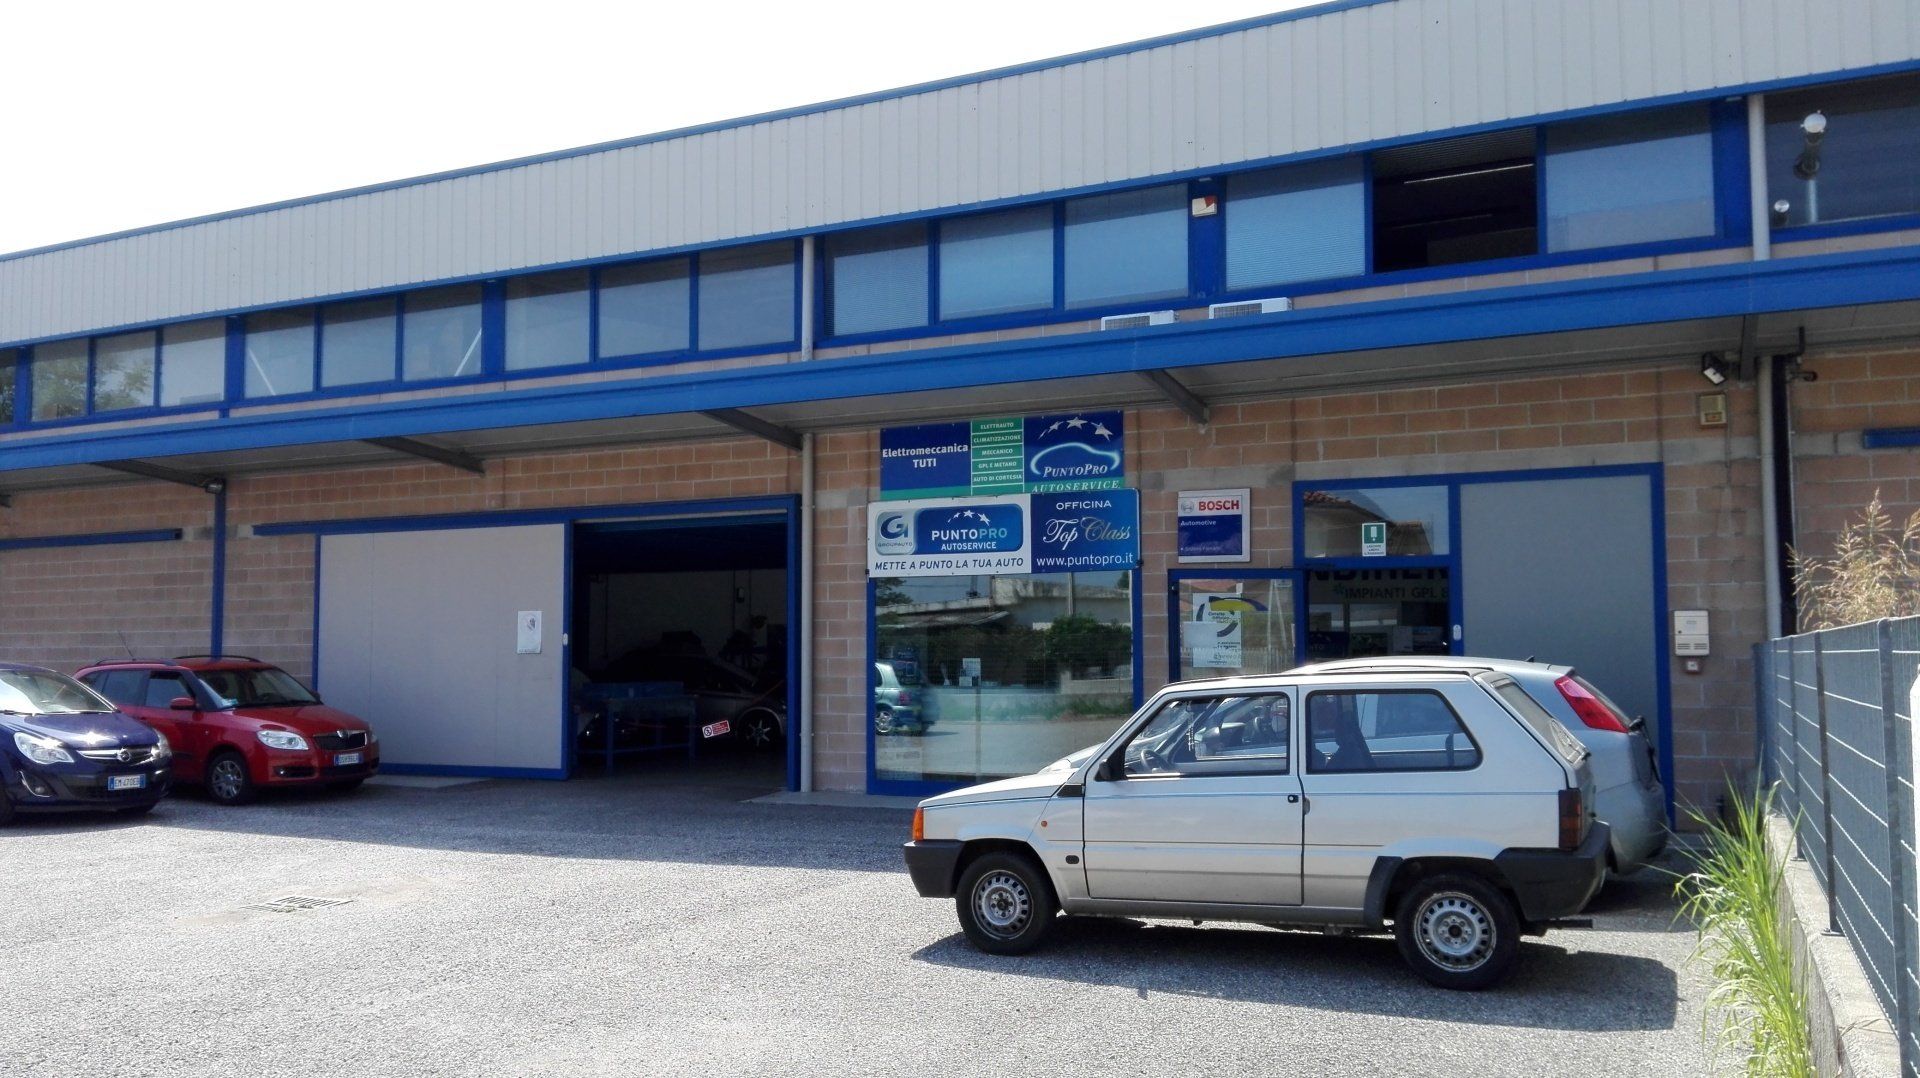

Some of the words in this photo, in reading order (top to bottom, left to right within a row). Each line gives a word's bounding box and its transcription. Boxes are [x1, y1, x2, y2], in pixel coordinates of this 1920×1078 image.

[980, 422, 1014, 430] ELETTRAUTO
[973, 435, 1021, 443] CLIMATIZZAZIONE
[882, 443, 969, 458] Elettromeccanica
[912, 458, 937, 468] TUTI
[1032, 480, 1120, 492] AUTOSERVICE
[1056, 500, 1112, 510] OFFICINA
[1198, 499, 1240, 511] BOSCH
[1180, 519, 1217, 527] Automotive
[931, 527, 1008, 541] PUNTOPRO
[1042, 518, 1079, 550] Top
[1080, 516, 1131, 541] Class
[940, 541, 997, 551] AUTOSERVICE
[874, 561, 906, 571] METTE
[909, 561, 916, 570] A
[919, 560, 953, 570] PUNTO
[955, 559, 968, 569] LA
[972, 559, 992, 568] TUA
[995, 557, 1024, 567] AUTO
[1036, 552, 1133, 568] www.puntopro.it
[1345, 587, 1406, 600] IMPIANTI
[1411, 586, 1438, 598] GPL
